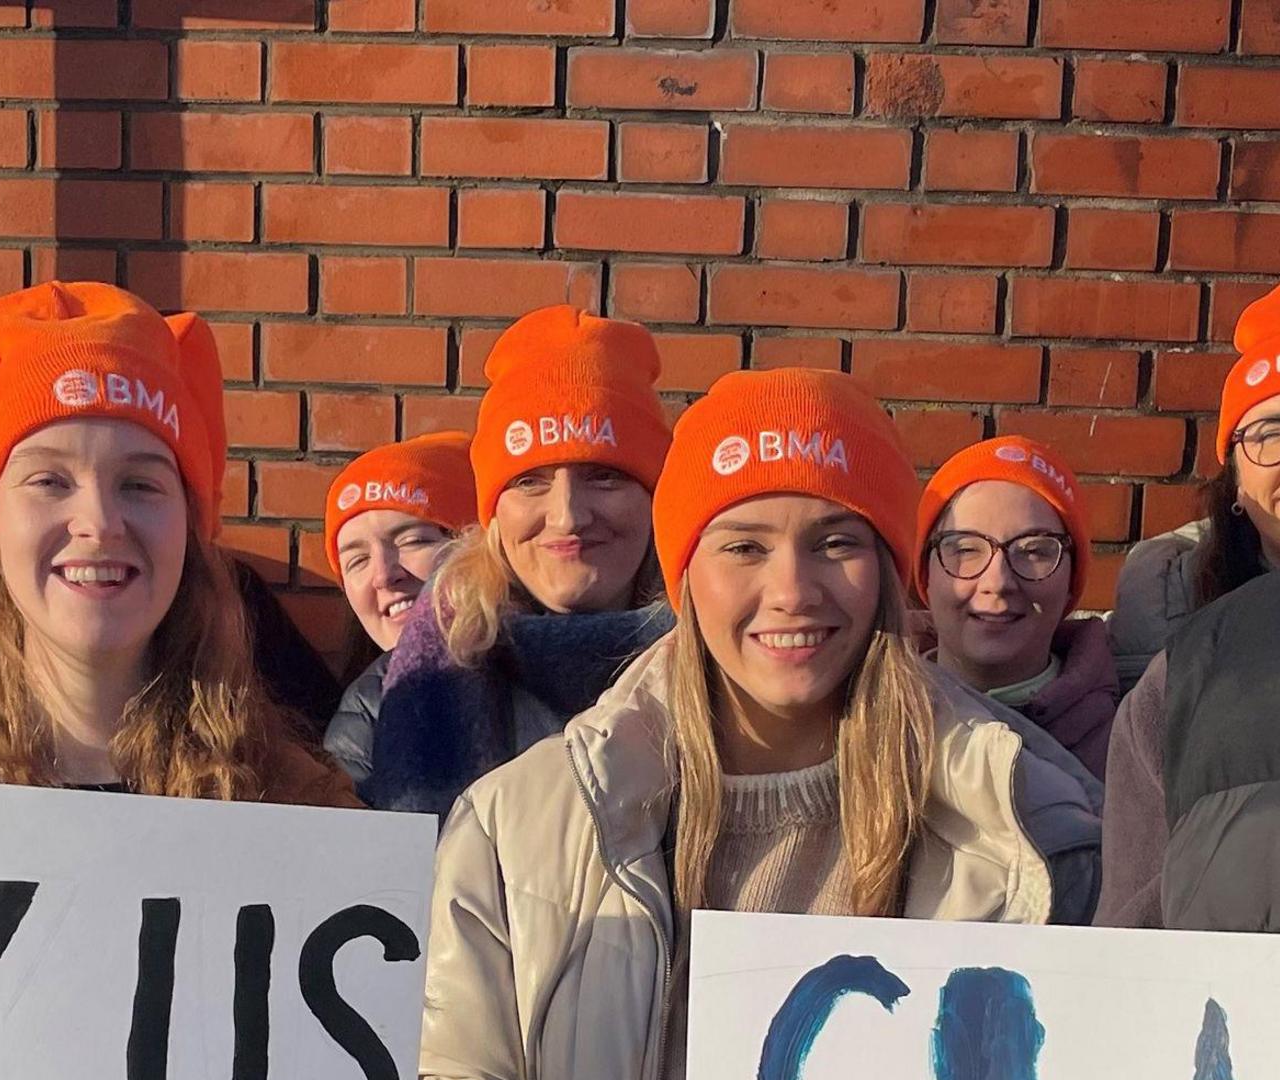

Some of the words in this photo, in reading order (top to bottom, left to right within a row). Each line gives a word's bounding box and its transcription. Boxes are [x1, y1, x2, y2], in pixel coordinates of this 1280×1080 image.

[106, 373, 181, 442] BMA
[538, 414, 618, 447] BMA
[757, 430, 849, 475] BMA
[365, 480, 431, 505] BMA
[1032, 454, 1075, 502] BMA
